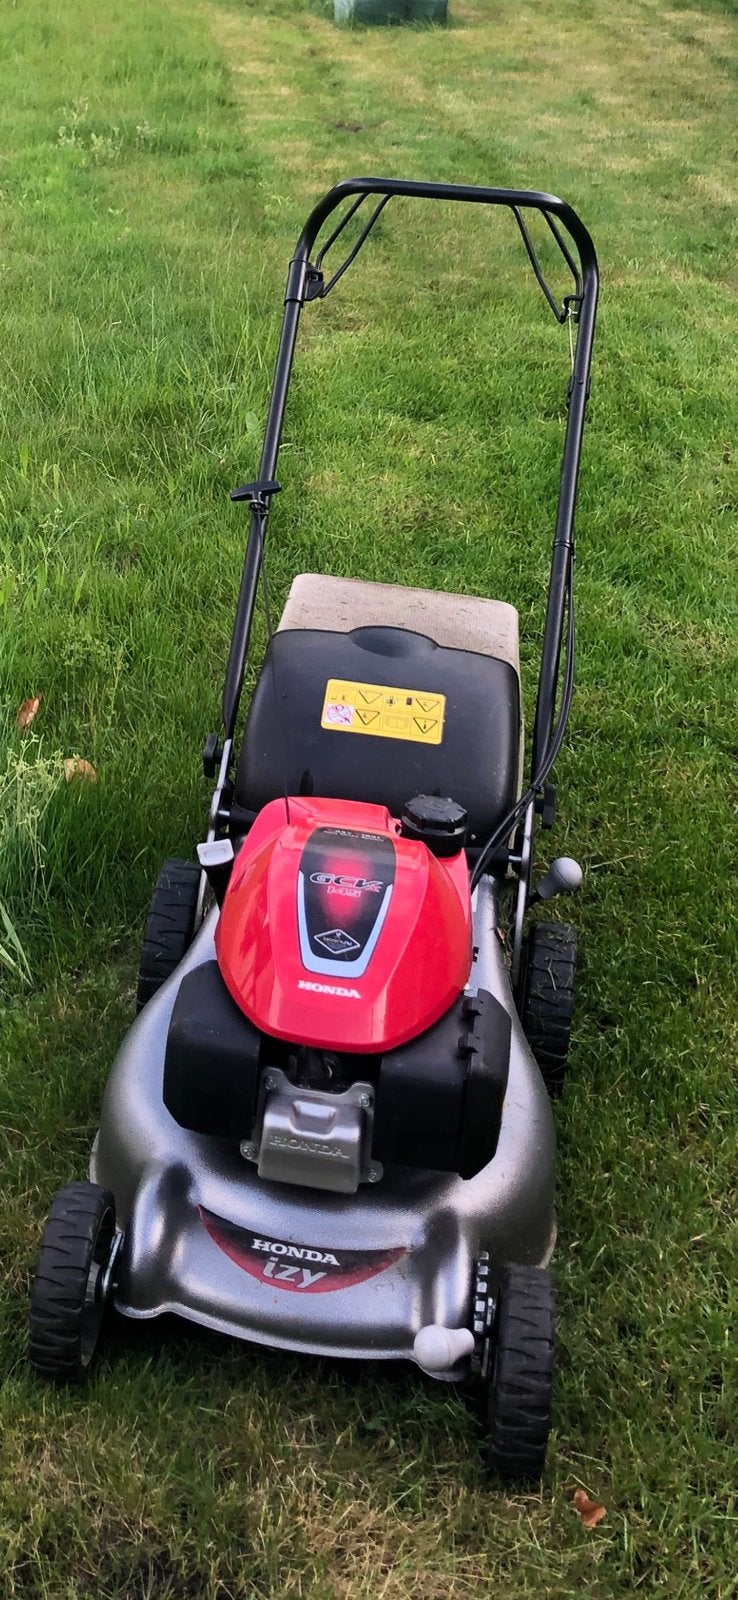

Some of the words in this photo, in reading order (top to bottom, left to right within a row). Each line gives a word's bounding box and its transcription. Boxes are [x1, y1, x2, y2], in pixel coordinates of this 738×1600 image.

[297, 980, 362, 999] HONDA
[269, 1136, 350, 1159] HONDA
[251, 1238, 341, 1266] HONDA
[262, 1256, 328, 1289] izy
